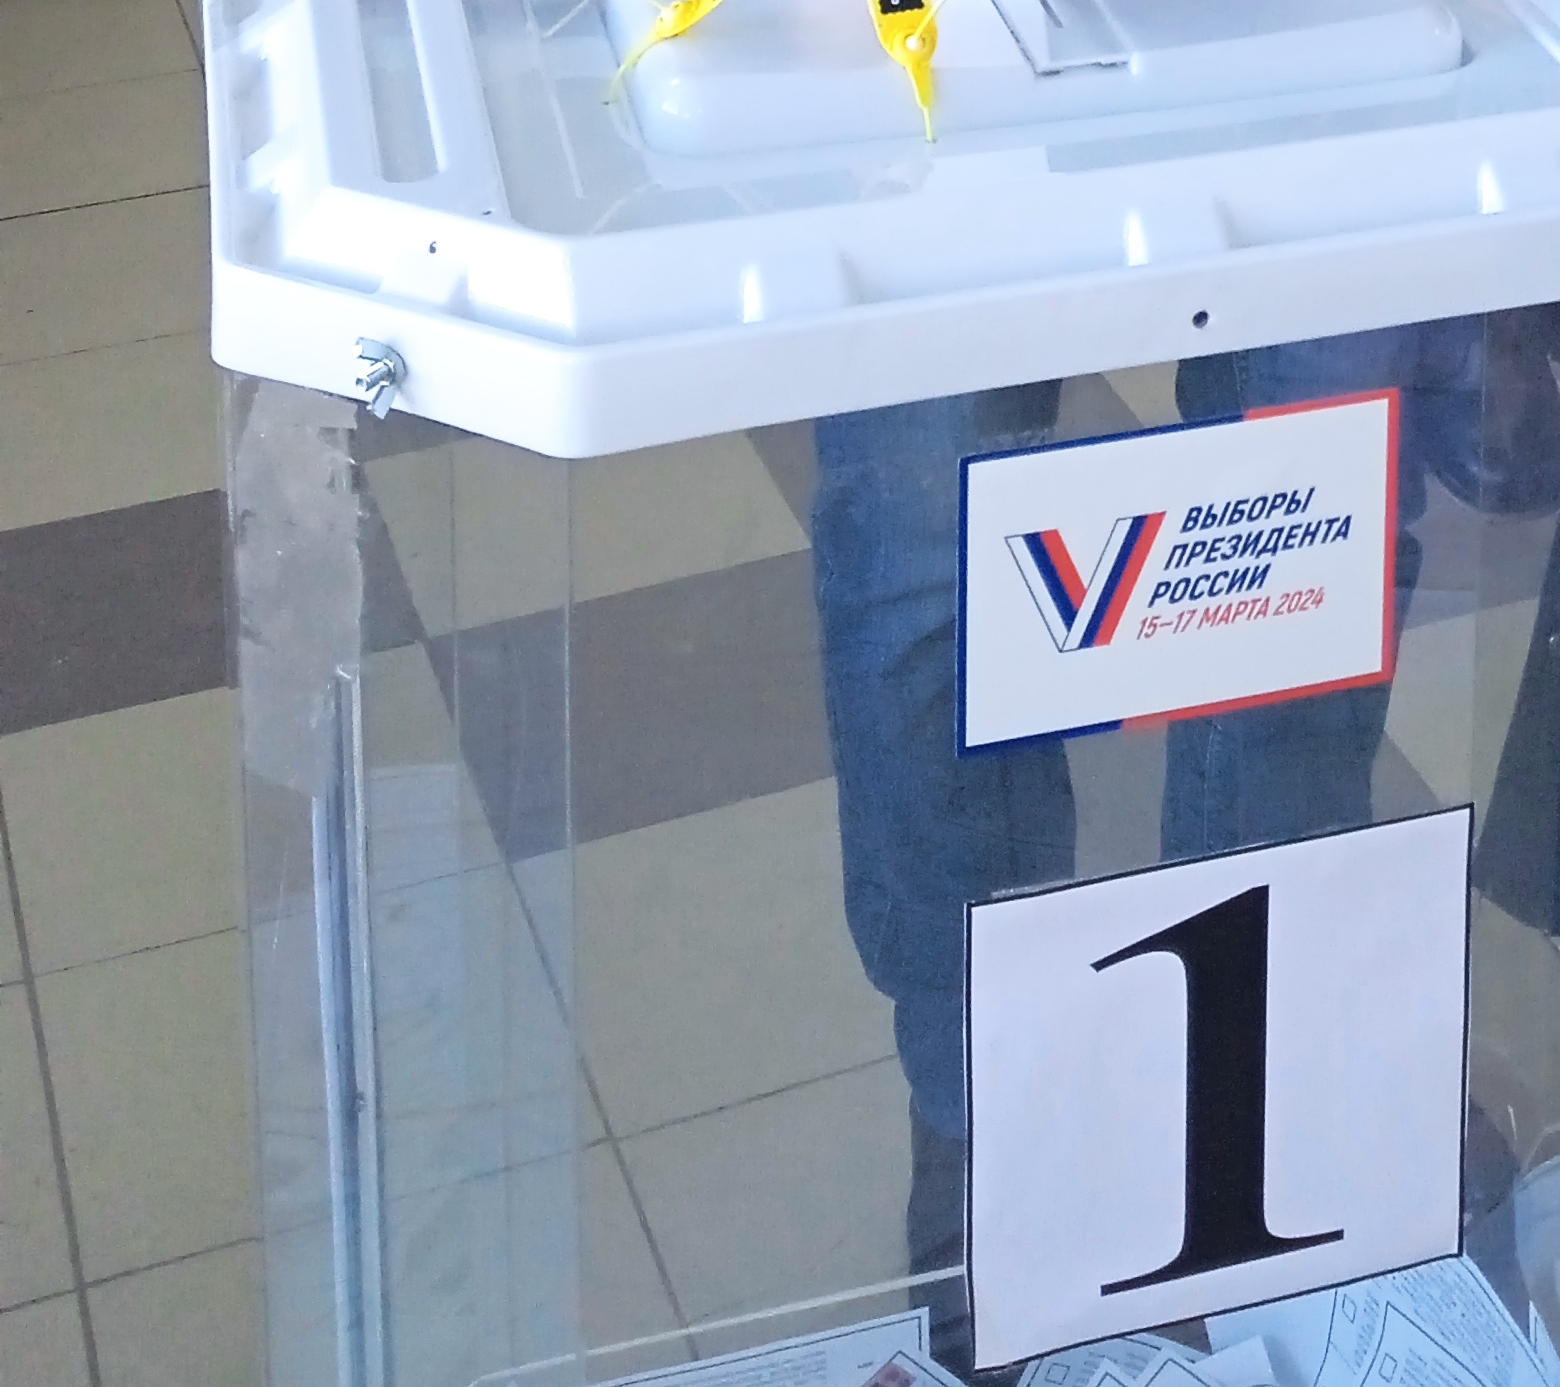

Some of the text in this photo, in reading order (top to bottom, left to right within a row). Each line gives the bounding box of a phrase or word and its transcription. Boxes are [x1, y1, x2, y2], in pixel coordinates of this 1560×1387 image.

[1179, 486, 1316, 534] ВЫБОРЫ
[1163, 514, 1353, 571] ПРЕЗИДЕНТА
[1147, 562, 1272, 609] РОССИИ
[1197, 595, 1271, 630] МАРТА
[1272, 586, 1325, 617] 2024
[1089, 884, 1345, 1297] 1
